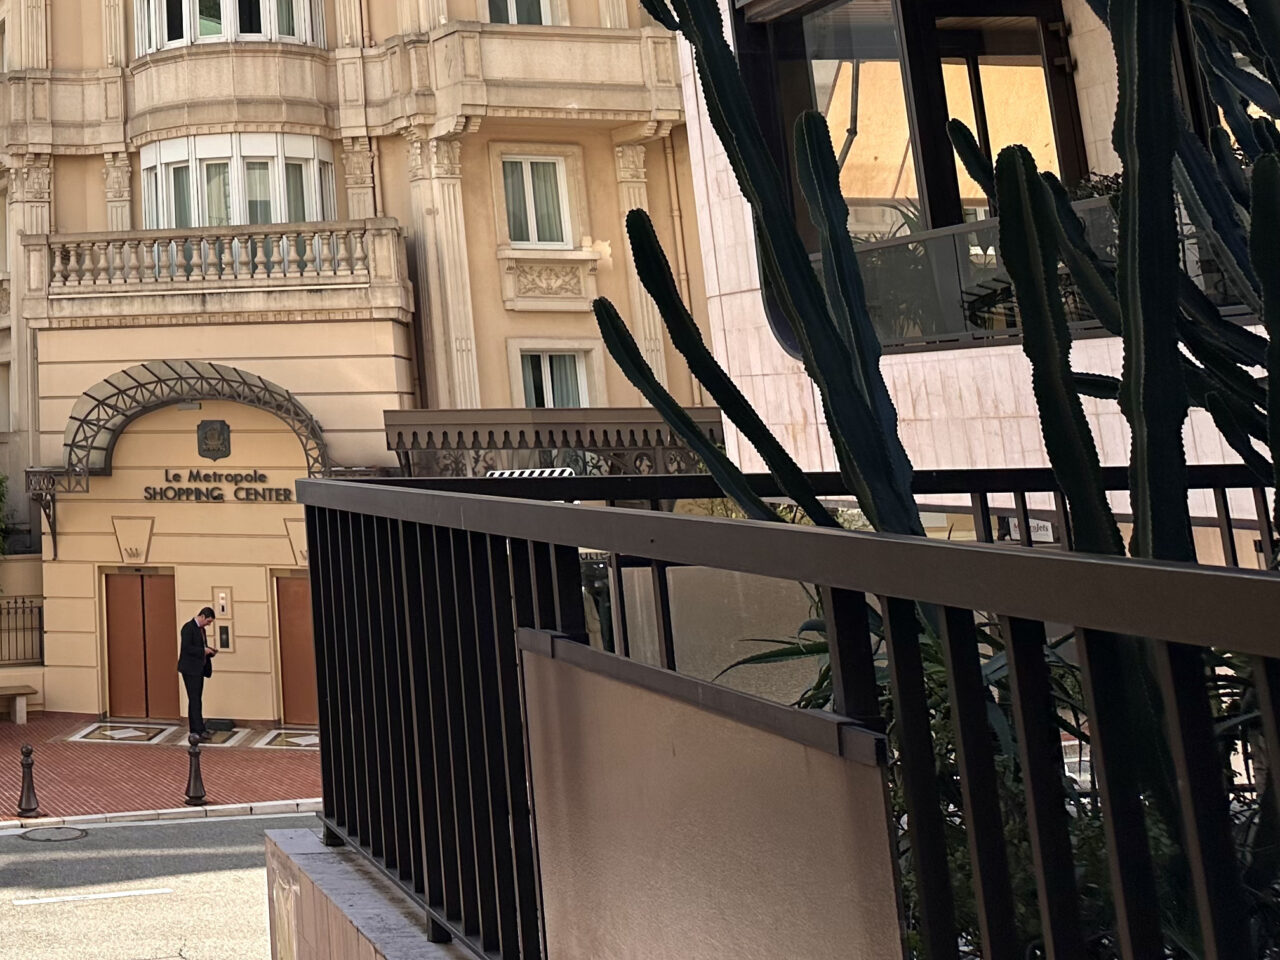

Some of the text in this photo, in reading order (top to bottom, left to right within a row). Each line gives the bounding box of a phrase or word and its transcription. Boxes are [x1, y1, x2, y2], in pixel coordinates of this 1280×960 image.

[165, 469, 268, 486] Le Metropole
[143, 486, 294, 501] SHOPPING CENTER
